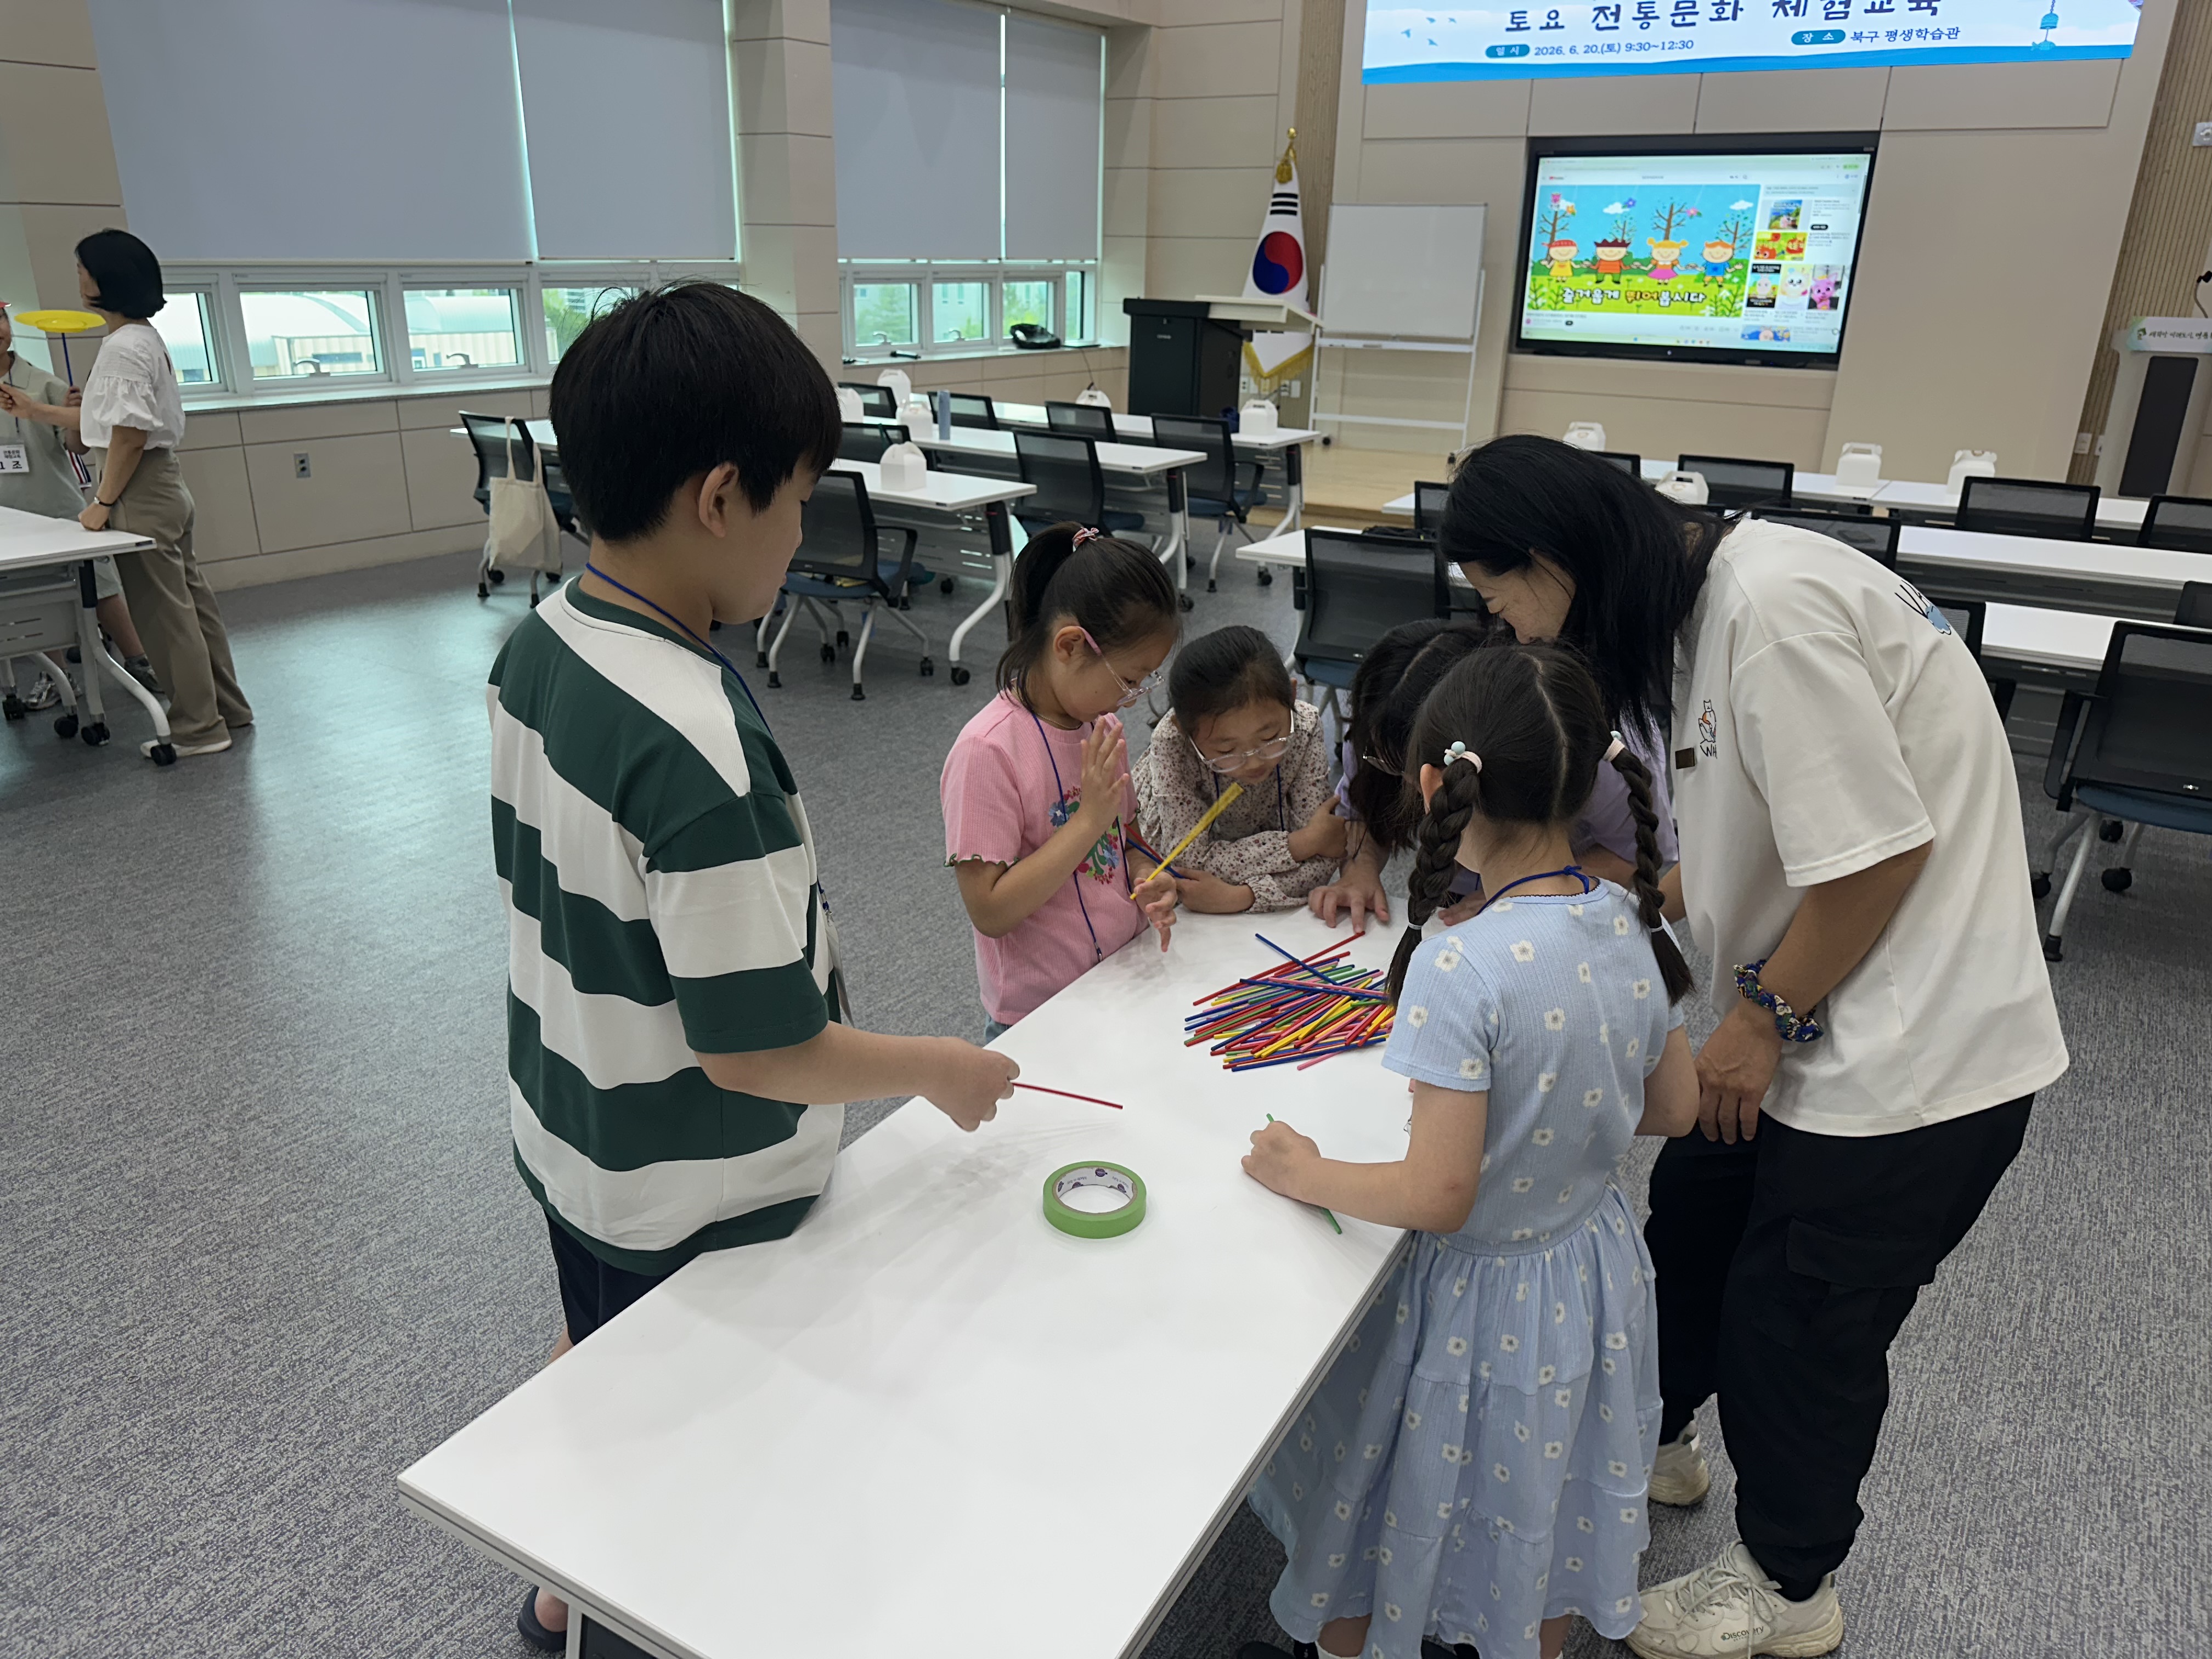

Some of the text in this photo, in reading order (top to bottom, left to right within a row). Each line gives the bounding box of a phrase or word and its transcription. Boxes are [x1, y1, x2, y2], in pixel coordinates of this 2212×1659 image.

[1505, 9, 1565, 32] 토요
[1592, 0, 1744, 31] 전통문화
[1850, 31, 1880, 43] 북구
[1884, 26, 1961, 42] 평생학습관
[1534, 46, 1565, 55] 2026.
[1625, 40, 1694, 52] 9:30~12:30
[12, 461, 22, 469] 조
